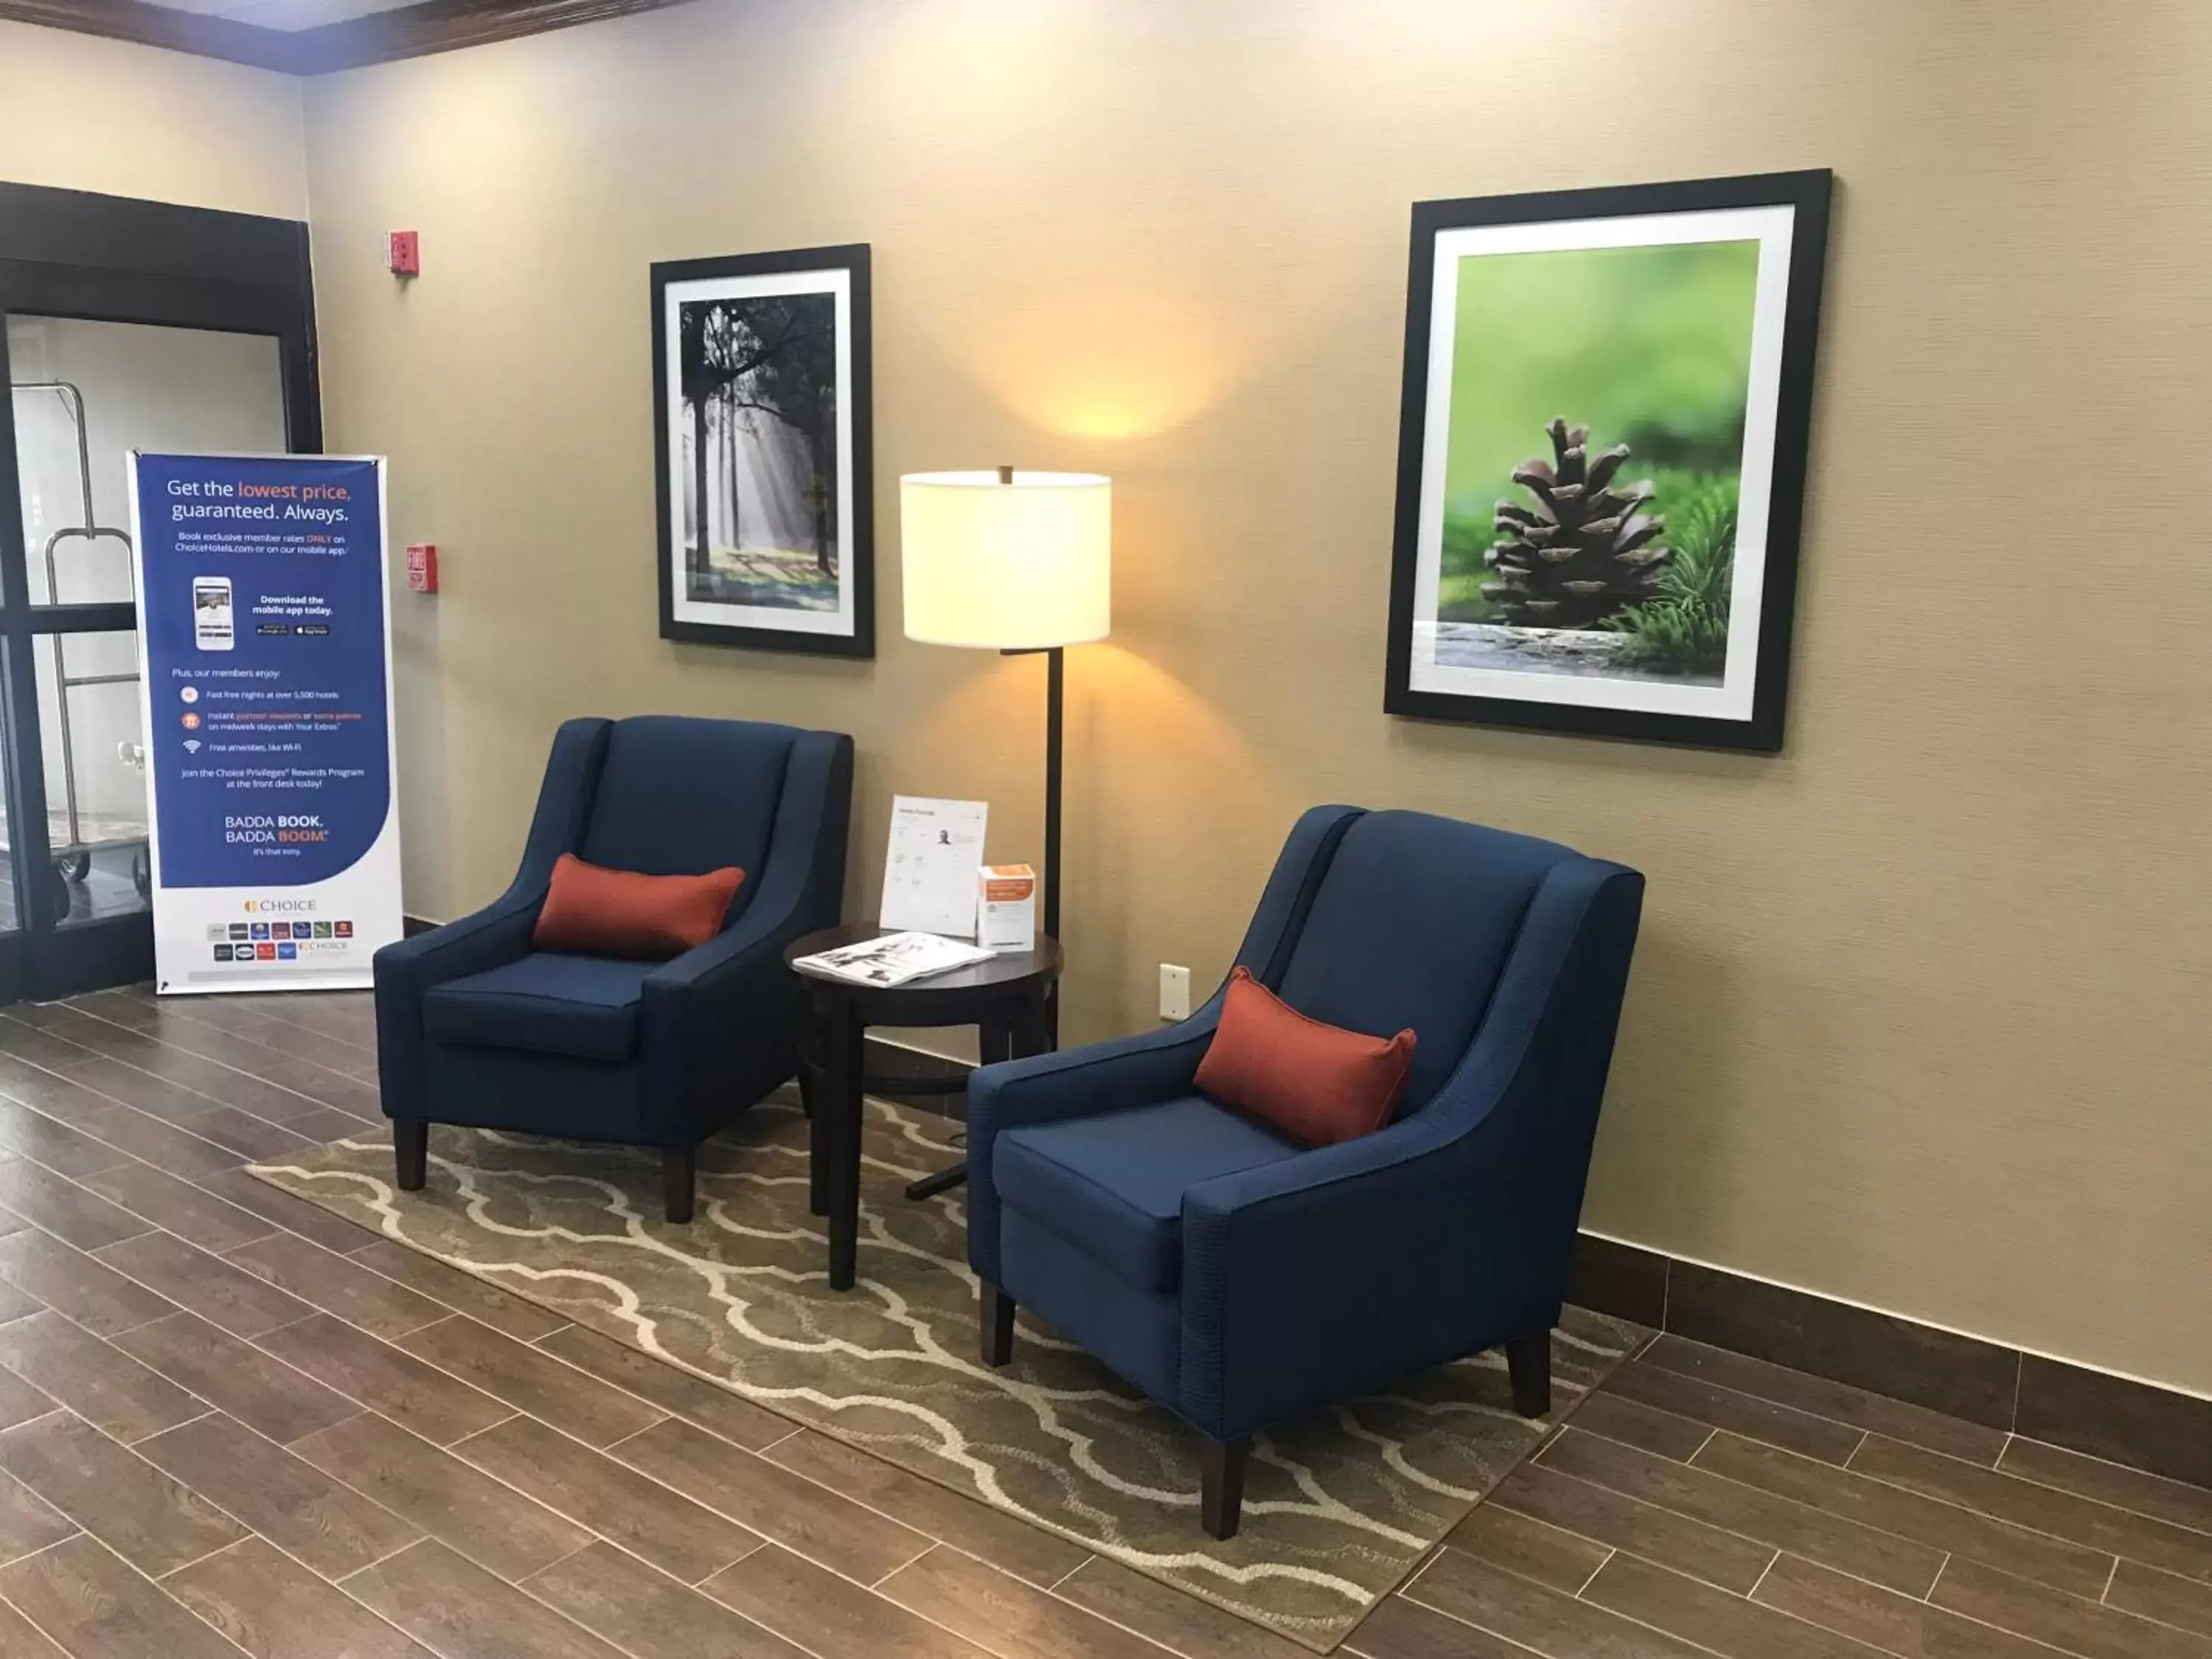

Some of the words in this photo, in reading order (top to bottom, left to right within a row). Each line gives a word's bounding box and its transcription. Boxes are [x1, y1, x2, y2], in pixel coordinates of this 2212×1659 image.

[167, 480, 200, 496] Get
[204, 481, 234, 497] the
[238, 481, 297, 498] lowest
[302, 484, 352, 502] price,
[172, 504, 280, 521] guaranteed.
[284, 504, 349, 524] Always.
[178, 532, 201, 541] Book
[204, 532, 243, 542] exclusive
[244, 533, 281, 542] member
[283, 534, 305, 543] rates
[306, 535, 332, 543] ONLY
[175, 543, 254, 553] ChoiceHotels.com
[297, 544, 327, 554] mobile
[260, 595, 307, 604] Download
[308, 596, 324, 604] the
[252, 606, 284, 614] mobile
[285, 608, 303, 616] app
[305, 606, 333, 616] today.
[172, 669, 193, 678] Plus,
[212, 669, 254, 678] members
[256, 669, 281, 680] enjoy:
[181, 769, 198, 779] Join
[200, 769, 215, 777] the
[216, 769, 245, 777] Choice
[328, 769, 365, 779] Program
[237, 780, 251, 788] the
[253, 780, 274, 788] front
[275, 779, 294, 788] desk
[225, 816, 275, 828] BADDA
[278, 815, 323, 827] BOOK.
[226, 830, 275, 842] BADDA
[260, 899, 317, 911] CHOICE
